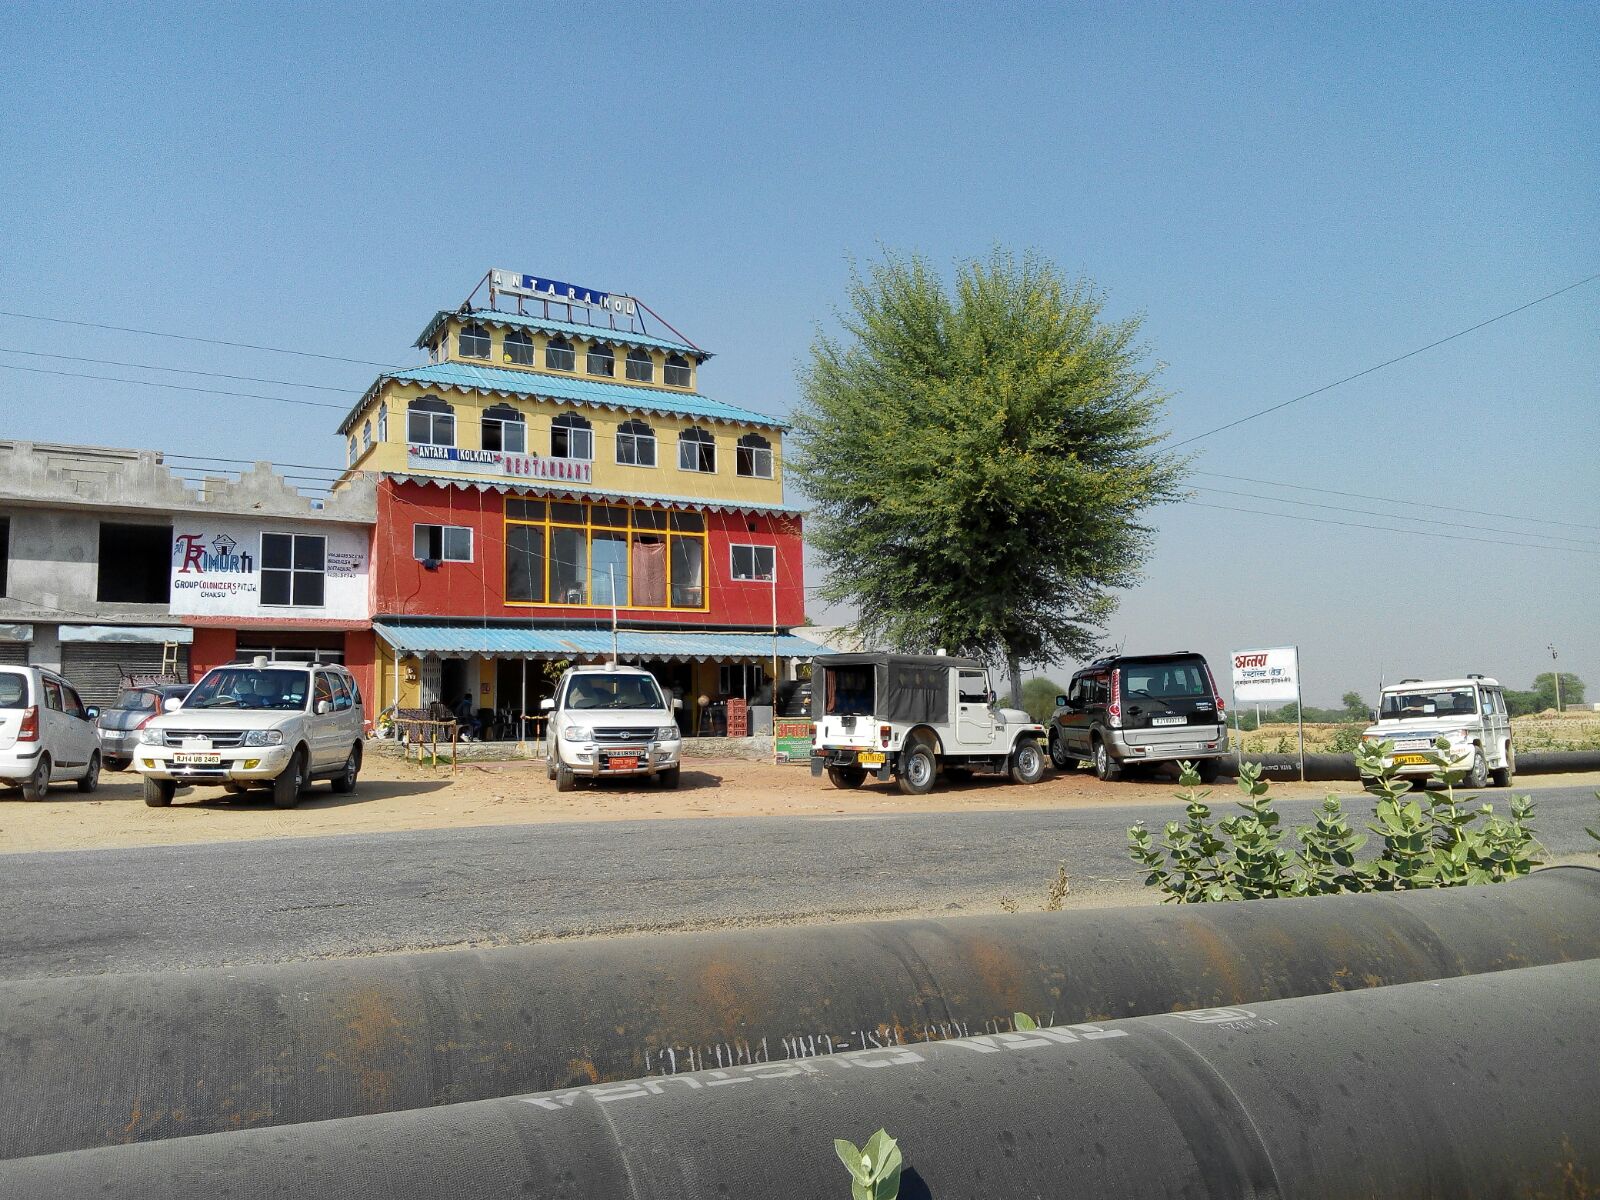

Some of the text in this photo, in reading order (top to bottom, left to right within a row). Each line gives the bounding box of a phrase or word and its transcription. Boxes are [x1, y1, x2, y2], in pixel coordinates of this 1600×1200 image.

[494, 272, 592, 304] ANTARA
[419, 446, 494, 463] ANTARA (KOLKATA)
[506, 457, 590, 480] RESTAURANT
[174, 579, 199, 589] GROUP
[199, 580, 237, 595] COLONIZERS
[1235, 654, 1268, 668] अन्तरा
[936, 1023, 1130, 1055] TATA
